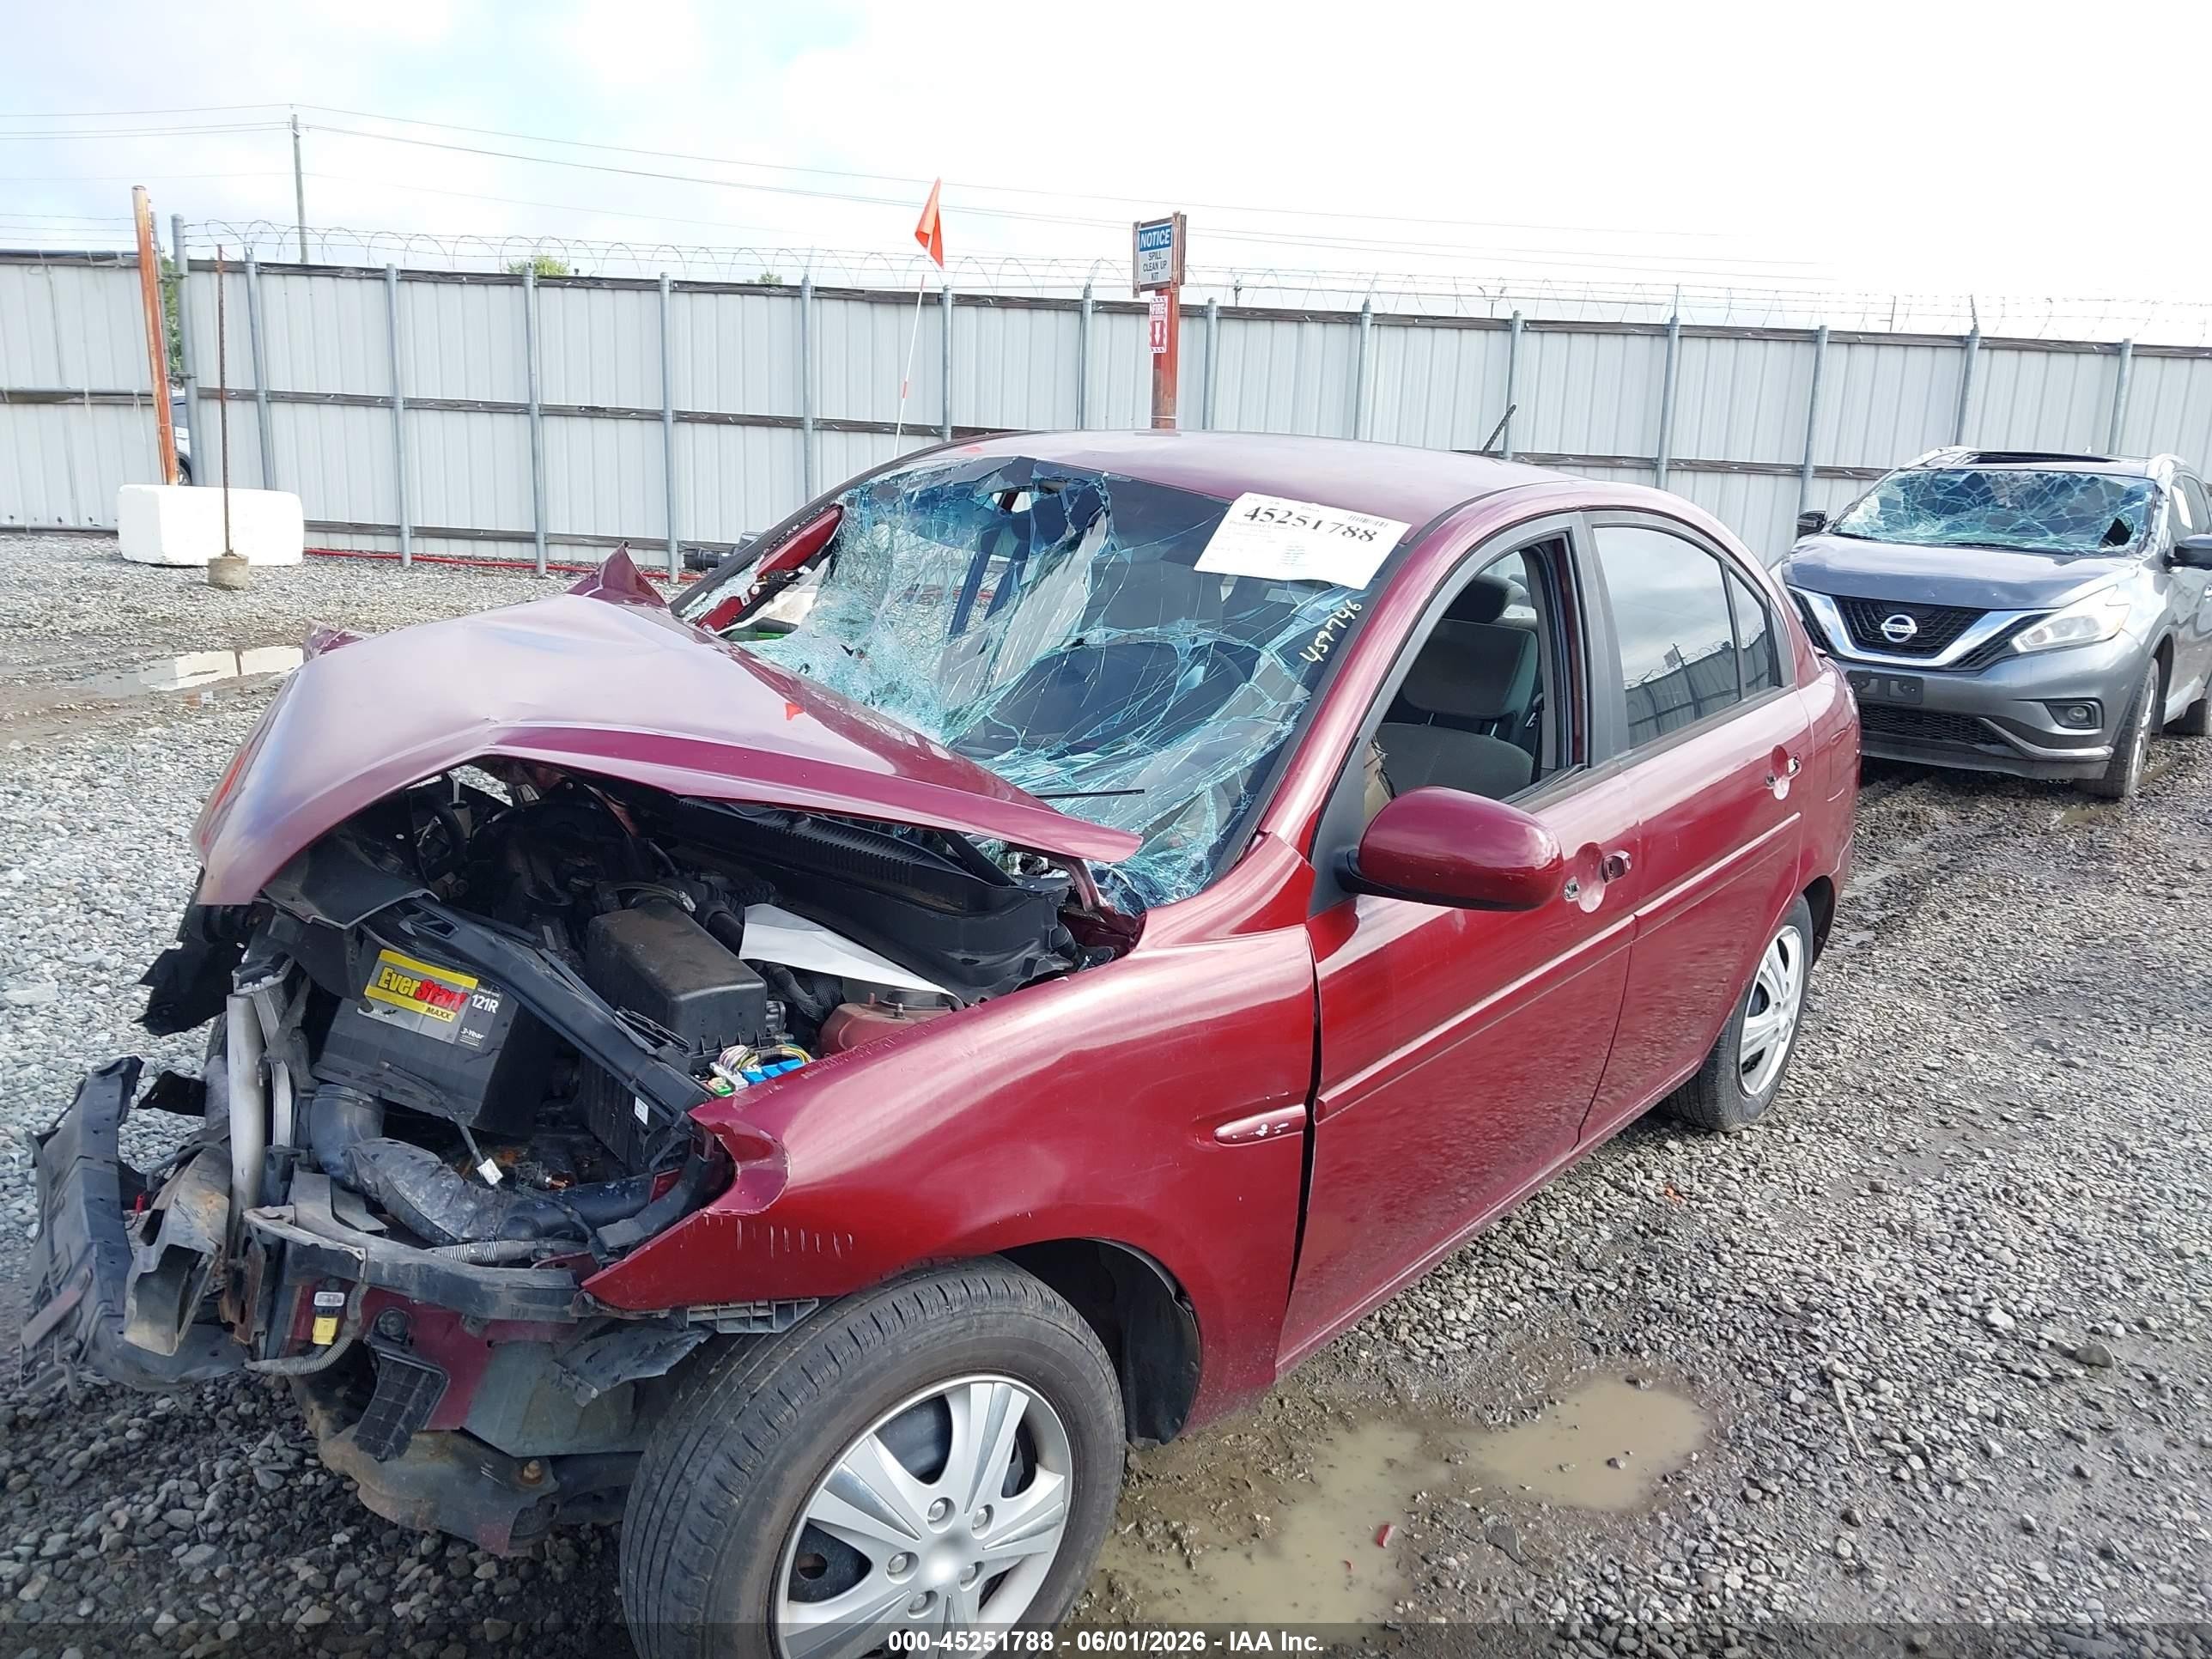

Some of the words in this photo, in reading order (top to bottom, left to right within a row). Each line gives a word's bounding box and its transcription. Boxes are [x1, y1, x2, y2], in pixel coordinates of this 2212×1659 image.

[1140, 228, 1170, 248] NOTICE
[1148, 251, 1162, 261] SPILL
[1143, 262, 1158, 273] CLEAN
[1160, 260, 1167, 270] UP
[1151, 271, 1159, 282] KIT
[1243, 506, 1378, 543] 45251788
[1299, 599, 1362, 663] 459746
[378, 966, 469, 1012] EverStart
[471, 994, 499, 1014] 121R
[425, 1006, 452, 1020] MAXX
[460, 1027, 485, 1040] 3-Year
